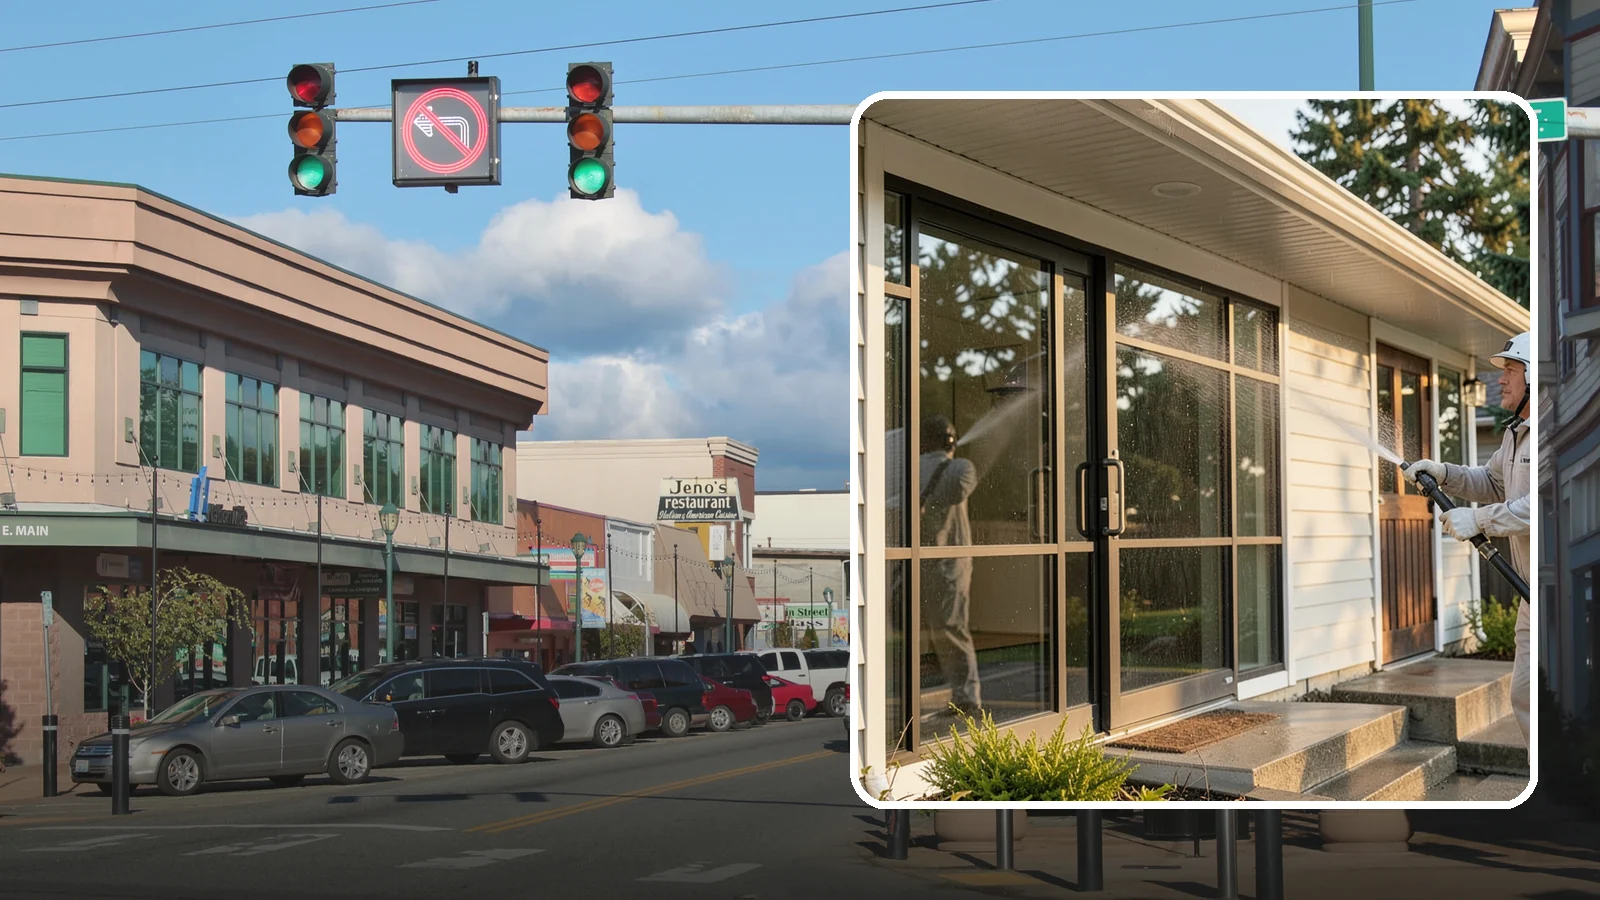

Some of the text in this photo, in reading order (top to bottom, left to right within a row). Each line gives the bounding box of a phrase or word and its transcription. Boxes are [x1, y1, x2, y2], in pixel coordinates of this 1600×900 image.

[670, 480, 728, 494] Jeno's
[665, 496, 731, 509] restaurant
[658, 510, 682, 519] Italian
[686, 510, 715, 519] American
[714, 509, 738, 519] Cuisine
[2, 525, 49, 536] E. MAIN
[797, 607, 828, 617] Street
